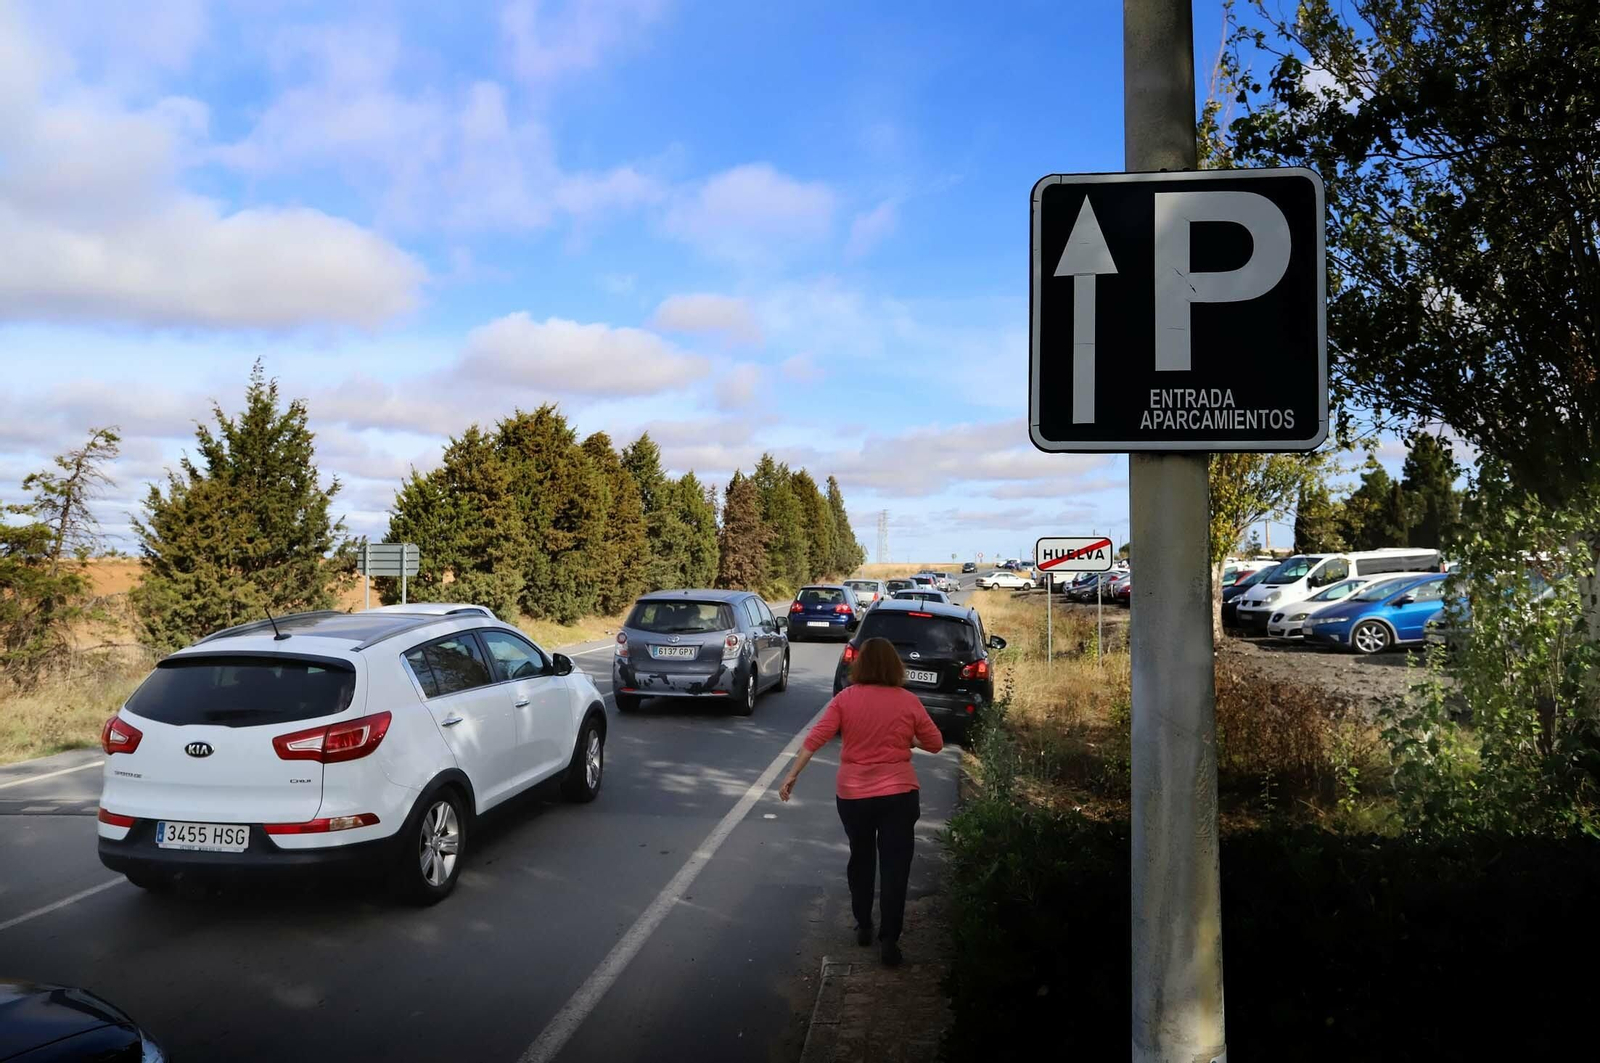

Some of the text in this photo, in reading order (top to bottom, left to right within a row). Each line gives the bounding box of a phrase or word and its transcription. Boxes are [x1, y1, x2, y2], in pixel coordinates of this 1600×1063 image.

[1154, 191, 1292, 371] P
[1149, 388, 1236, 408] ENTRADA
[1139, 409, 1295, 430] APARCAMIENTOS
[1043, 548, 1105, 560] HUELVA
[658, 647, 693, 656] 6137 GPX
[917, 671, 934, 682] GST
[188, 744, 209, 755] KIA
[167, 824, 245, 845] 3455 HSG
